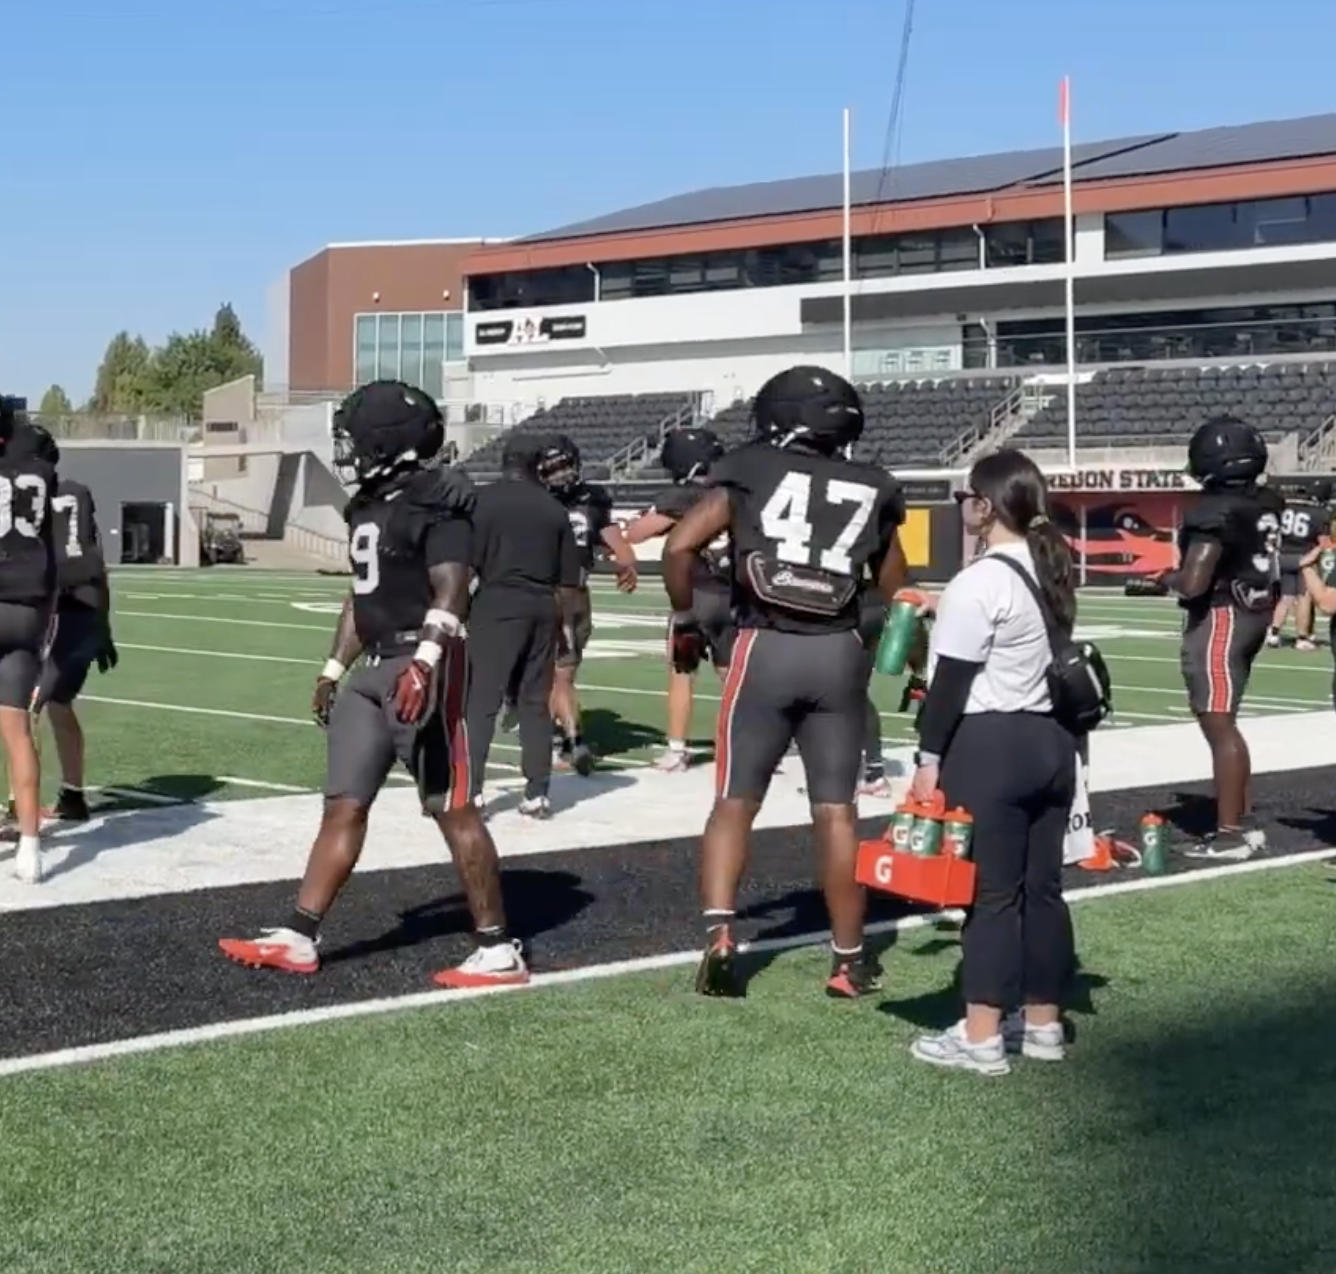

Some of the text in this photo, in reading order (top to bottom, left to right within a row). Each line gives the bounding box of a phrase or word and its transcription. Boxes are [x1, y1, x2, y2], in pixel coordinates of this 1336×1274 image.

[1119, 469, 1186, 488] STATE
[760, 471, 878, 574] 47
[1281, 508, 1310, 537] 96
[910, 831, 925, 850] G
[1144, 831, 1158, 846] G
[874, 855, 893, 884] G
